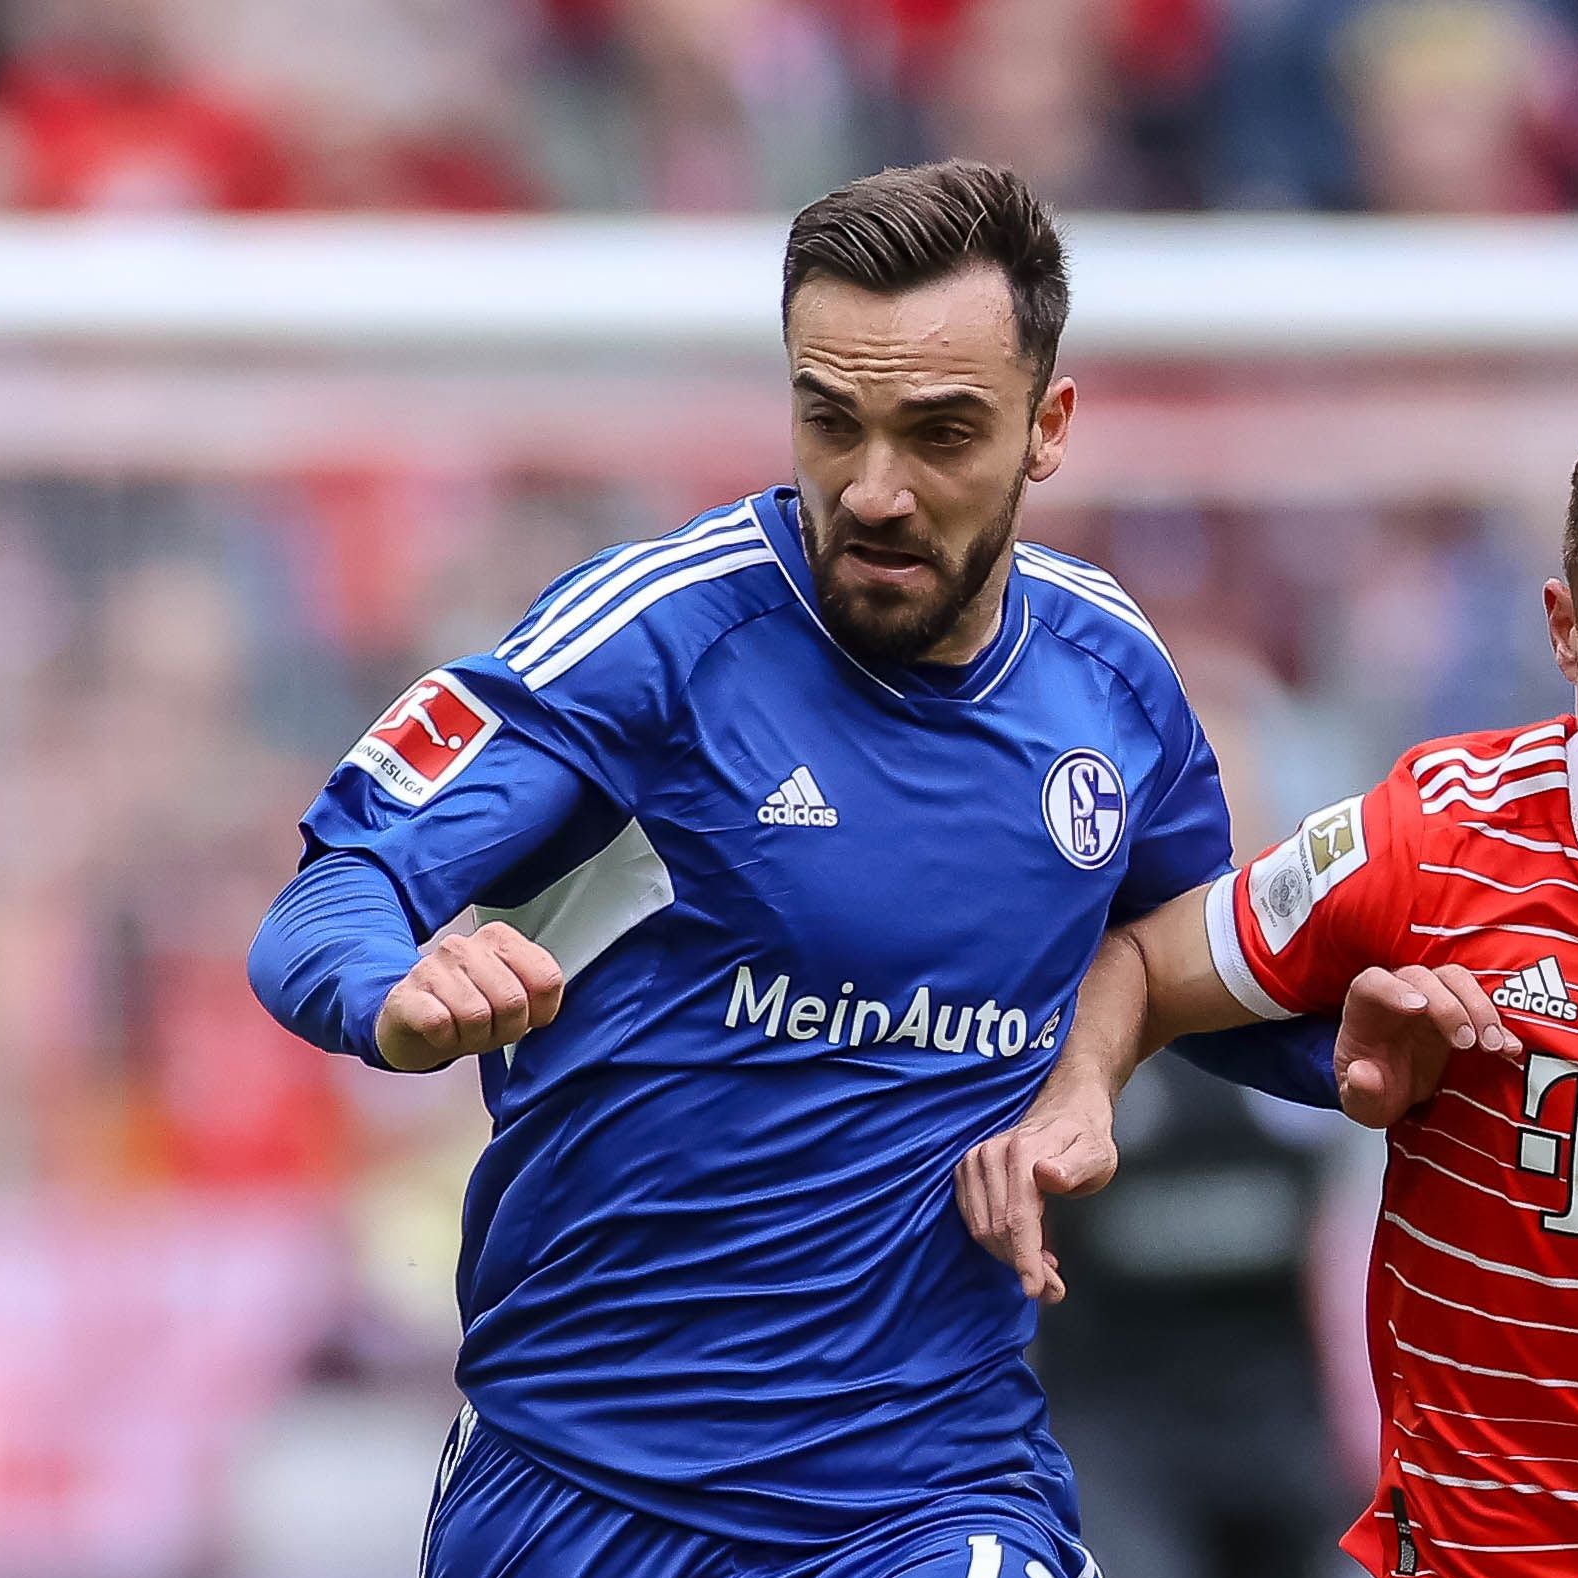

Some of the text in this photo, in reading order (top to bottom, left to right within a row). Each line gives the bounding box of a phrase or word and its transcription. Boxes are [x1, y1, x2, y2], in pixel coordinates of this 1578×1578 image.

[356, 743, 424, 796] UNDESLIGA
[757, 804, 839, 827] adidas
[1492, 987, 1578, 1021] adidas
